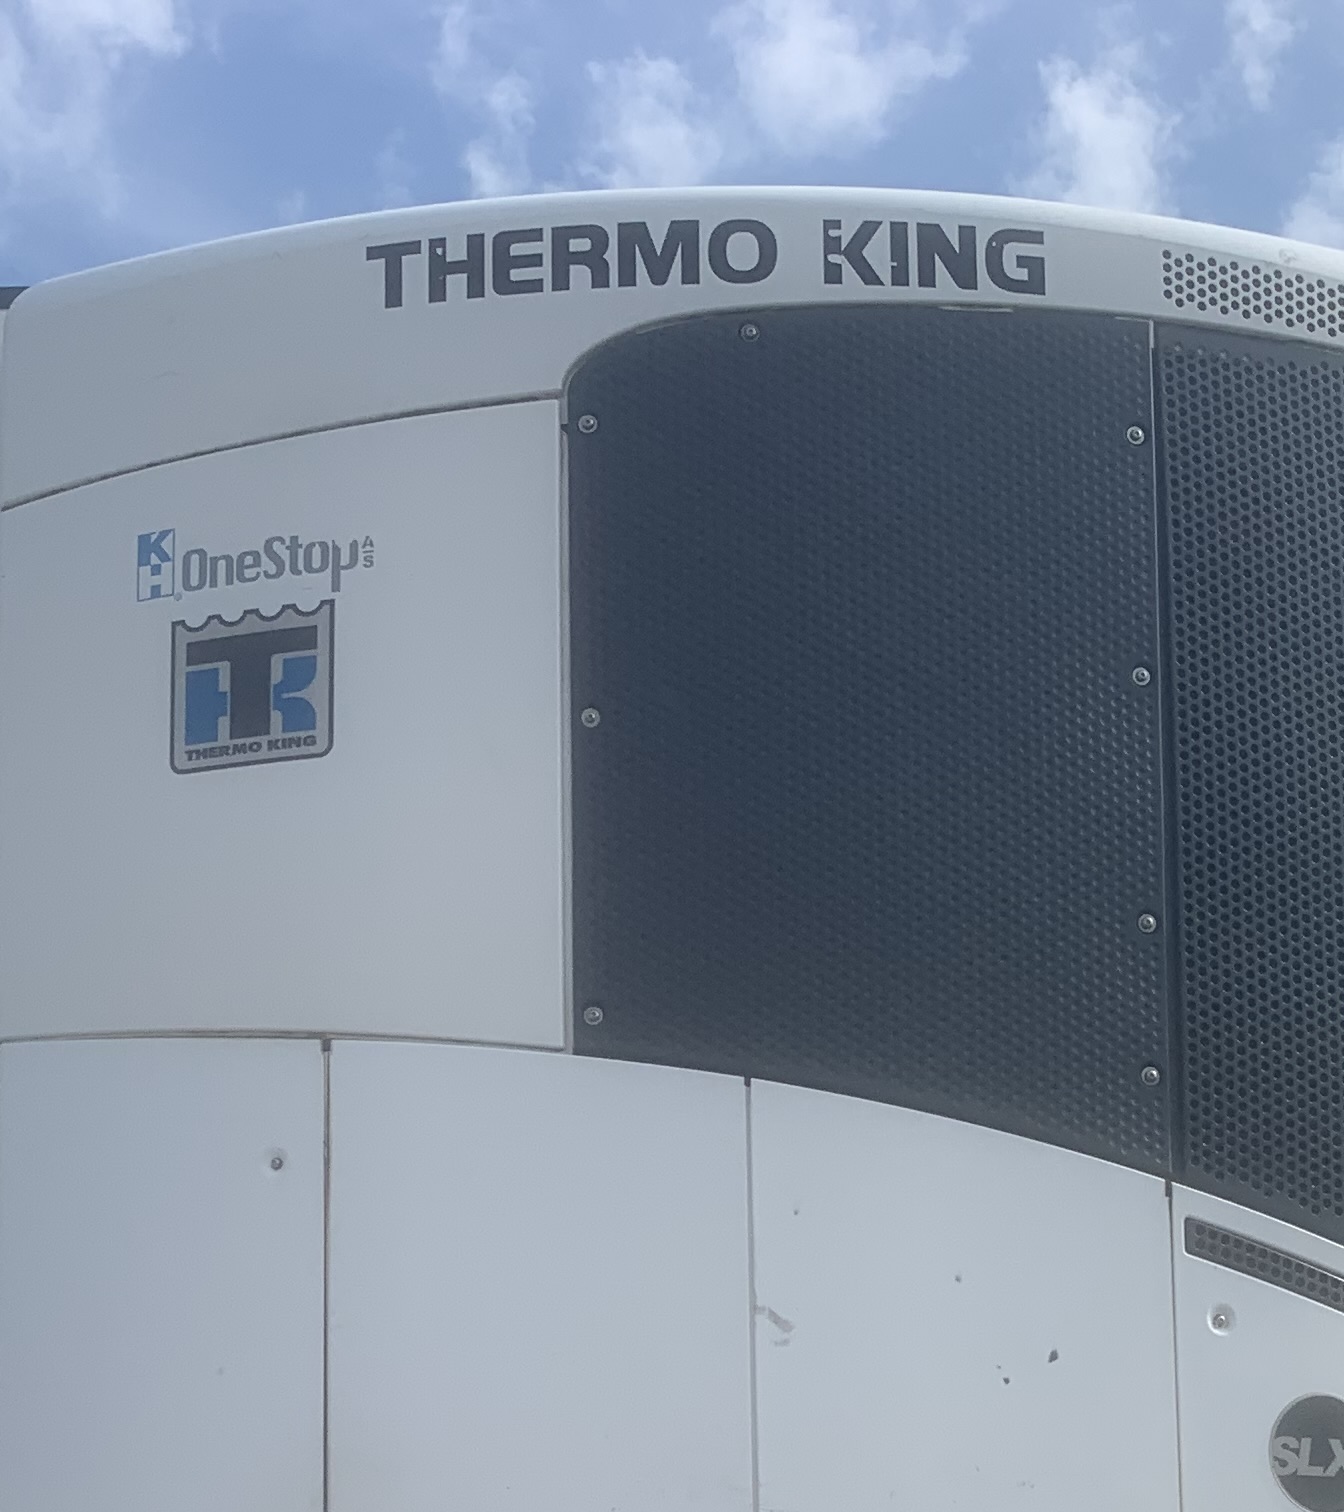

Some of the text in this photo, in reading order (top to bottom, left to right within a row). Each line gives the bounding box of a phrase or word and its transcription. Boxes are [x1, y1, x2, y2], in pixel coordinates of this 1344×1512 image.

[366, 218, 1047, 309] THERMO KING
[181, 535, 359, 593] OneStop
[184, 734, 318, 762] THERMO KING
